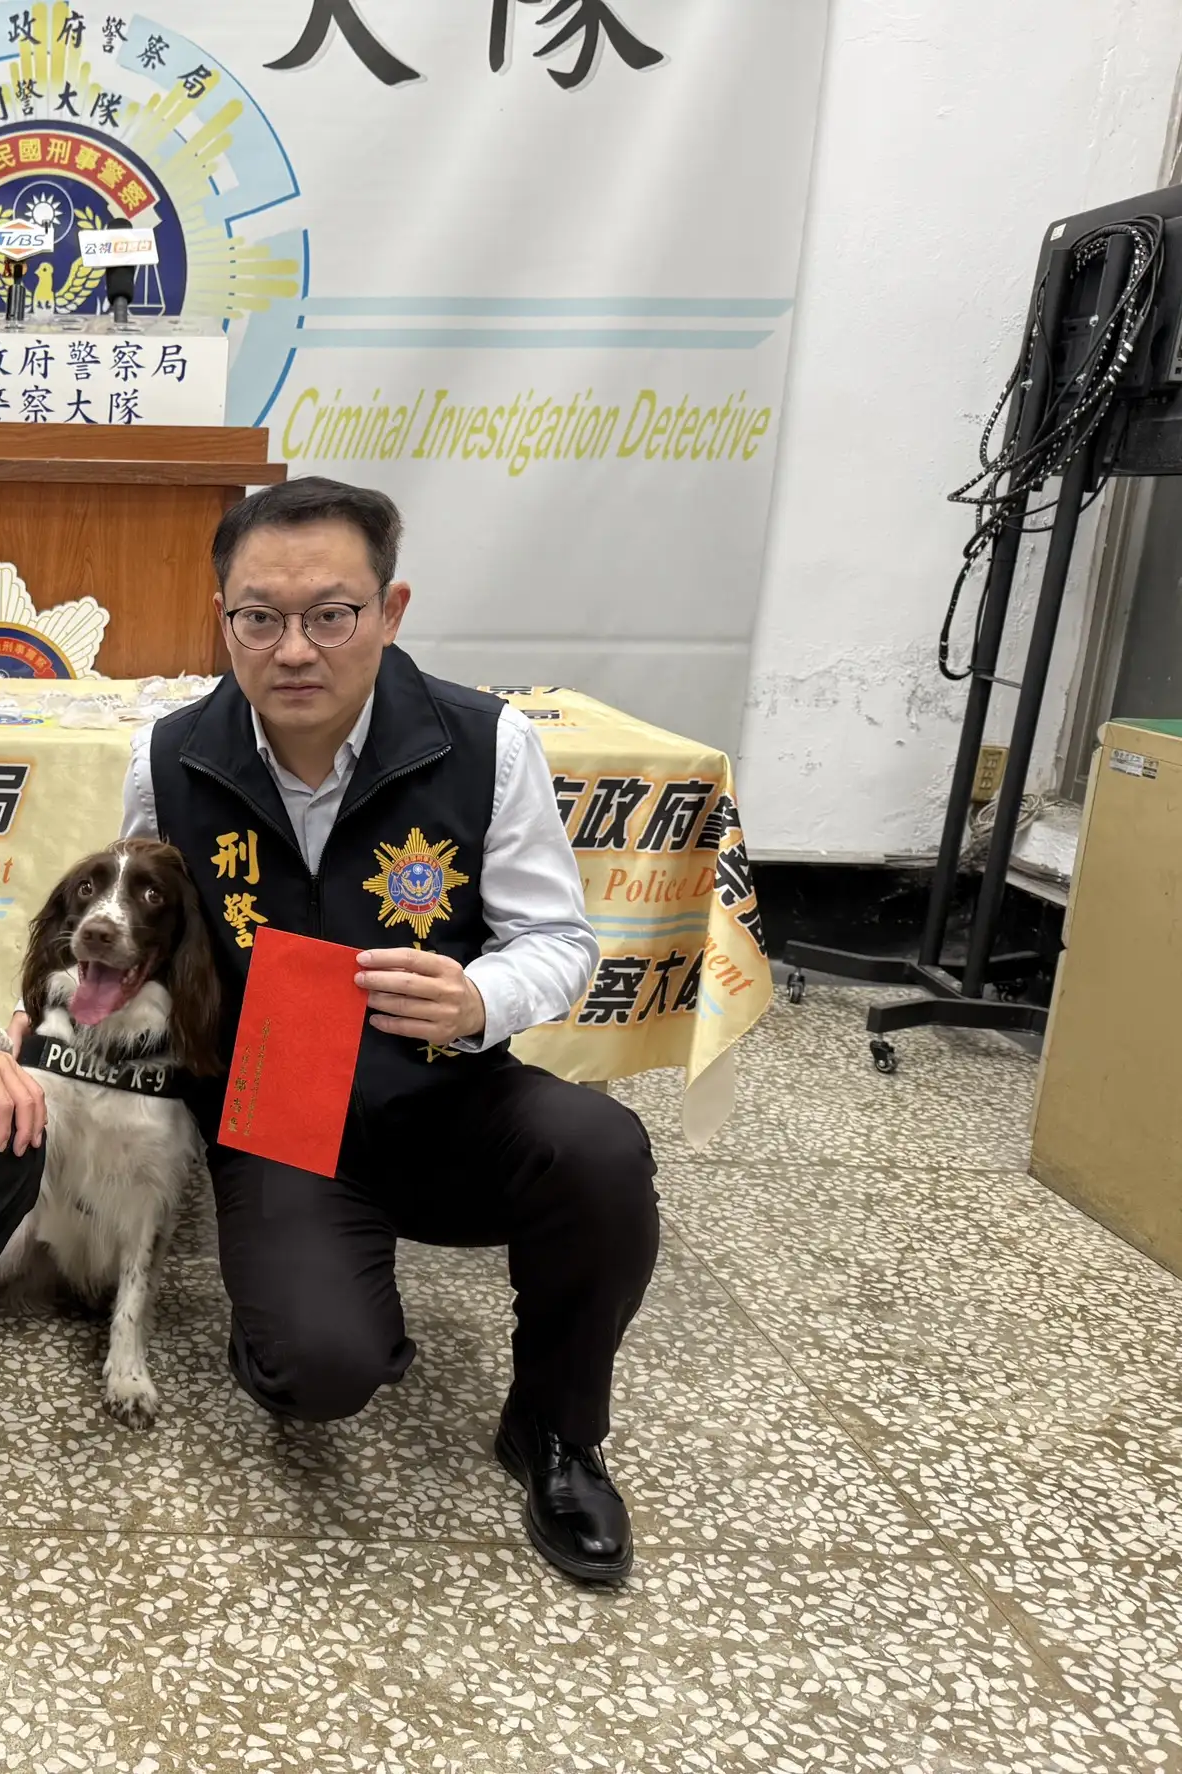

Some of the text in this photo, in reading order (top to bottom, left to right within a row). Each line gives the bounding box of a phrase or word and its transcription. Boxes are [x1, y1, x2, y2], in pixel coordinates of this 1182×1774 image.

[281, 387, 772, 477] Criminal Investigation Detective
[210, 829, 268, 949] 刑警
[603, 868, 687, 903] Police
[46, 1043, 166, 1093] POLICE K-9
